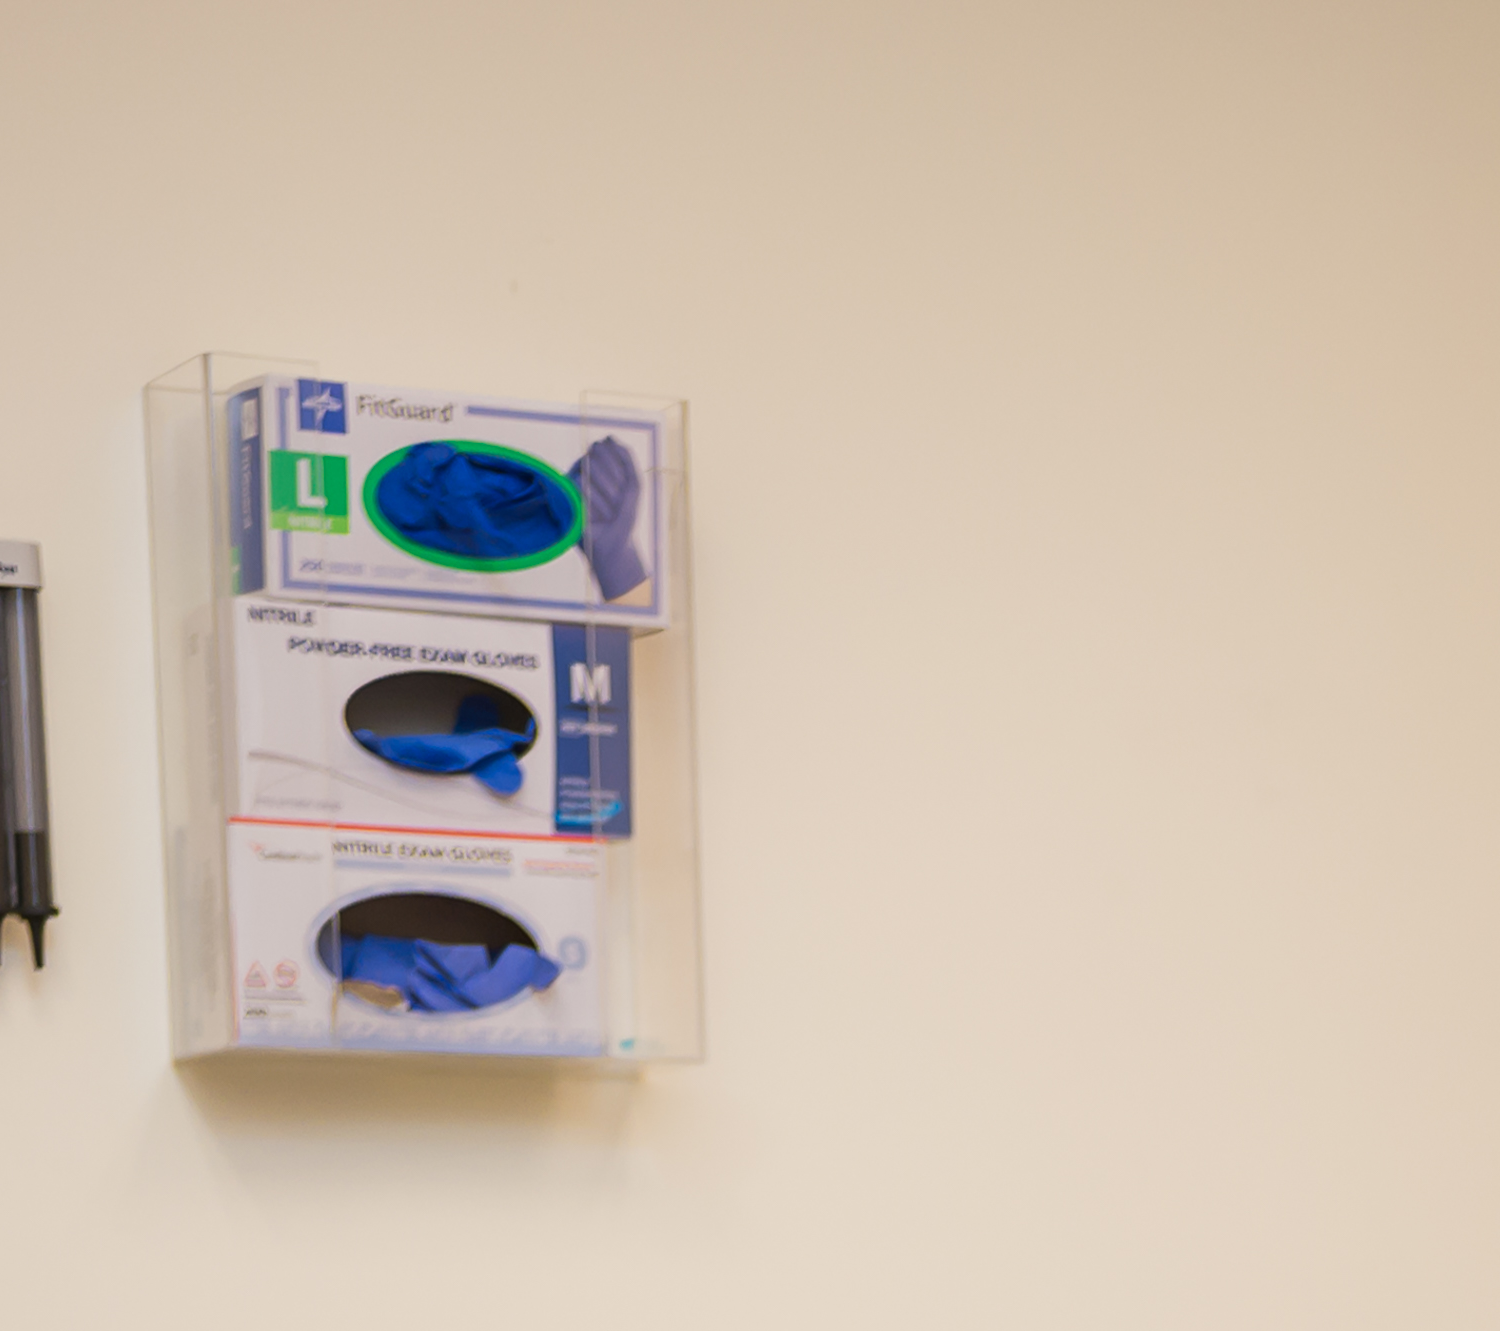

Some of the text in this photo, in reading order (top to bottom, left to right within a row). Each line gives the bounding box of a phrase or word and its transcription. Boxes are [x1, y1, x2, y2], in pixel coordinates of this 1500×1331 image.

[356, 394, 454, 422] FitGuard
[296, 458, 328, 508] L
[248, 607, 316, 625] NITRILE
[420, 647, 466, 664] EXAM
[472, 651, 539, 669] GLOVES
[569, 662, 611, 704] M
